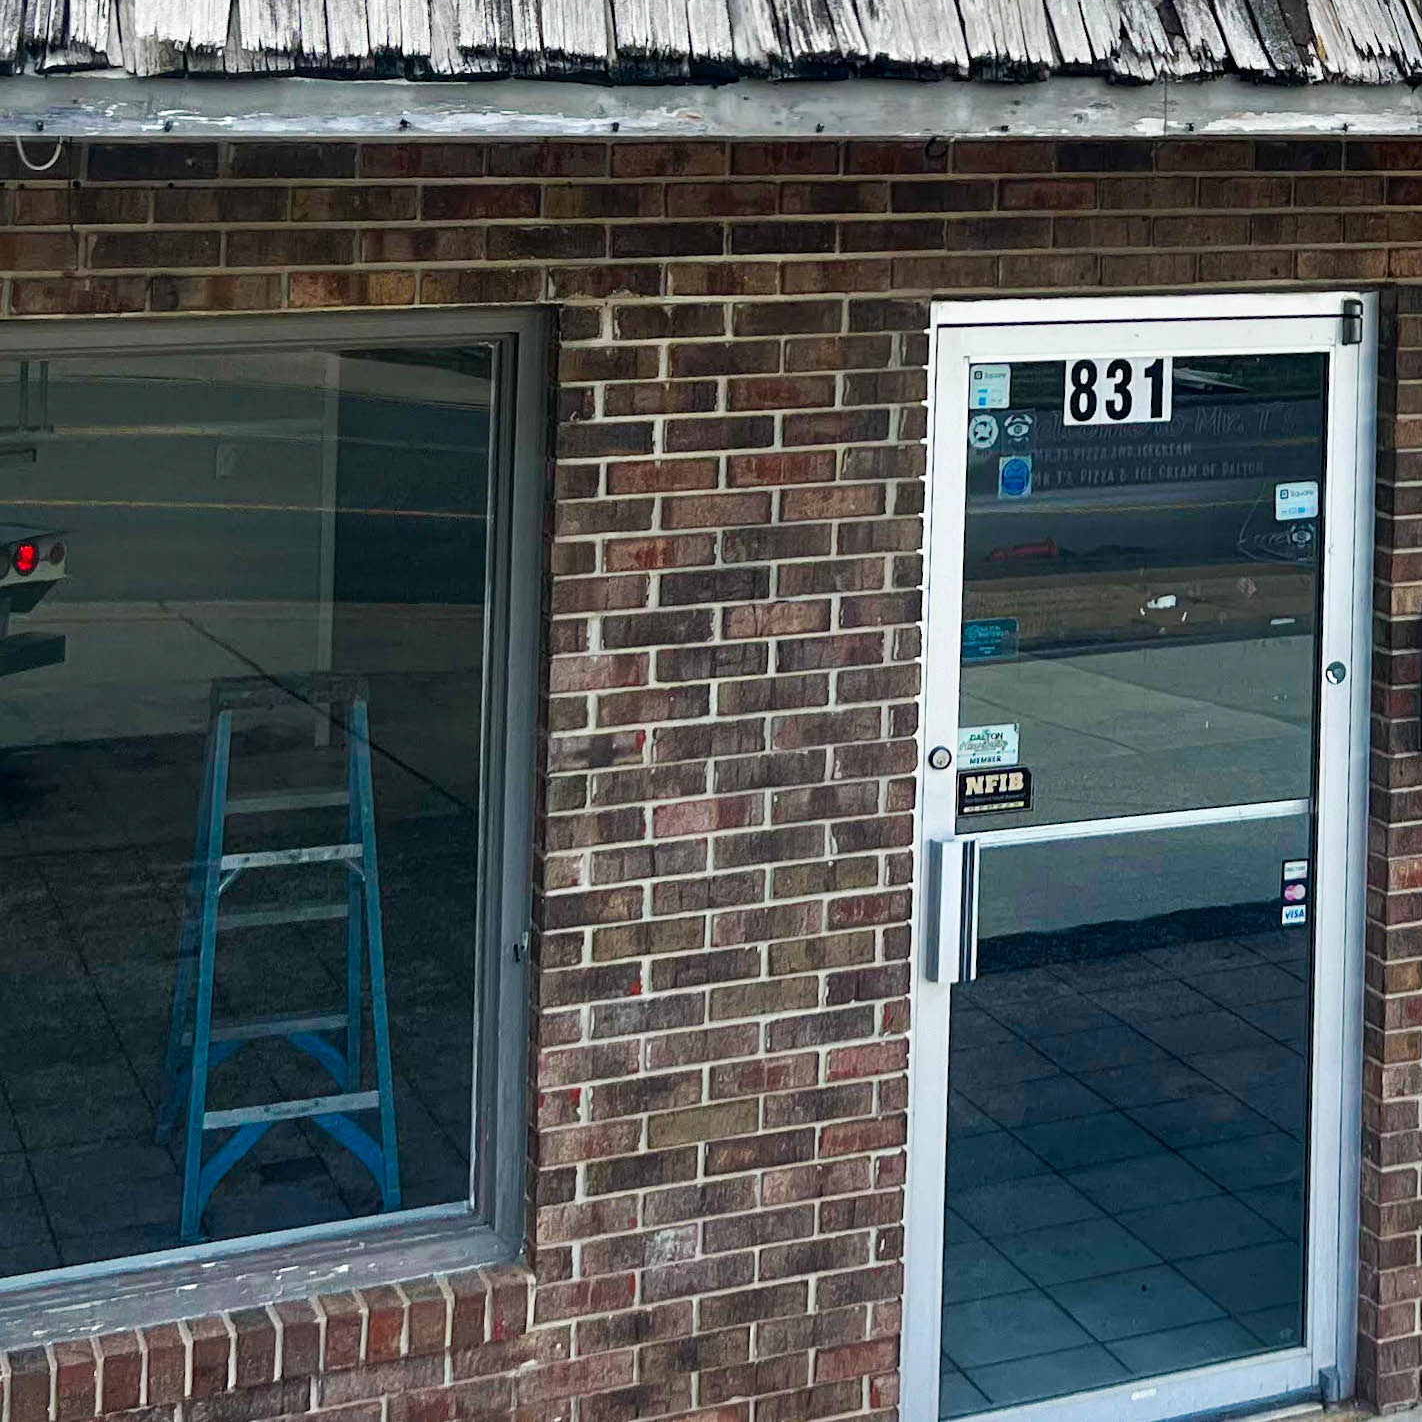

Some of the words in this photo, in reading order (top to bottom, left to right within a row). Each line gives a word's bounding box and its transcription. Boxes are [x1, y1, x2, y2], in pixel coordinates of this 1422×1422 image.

[1069, 358, 1164, 422] 831
[969, 732, 1004, 741] DALTON
[965, 771, 1025, 796] NFIB
[1285, 908, 1305, 920] VISA
